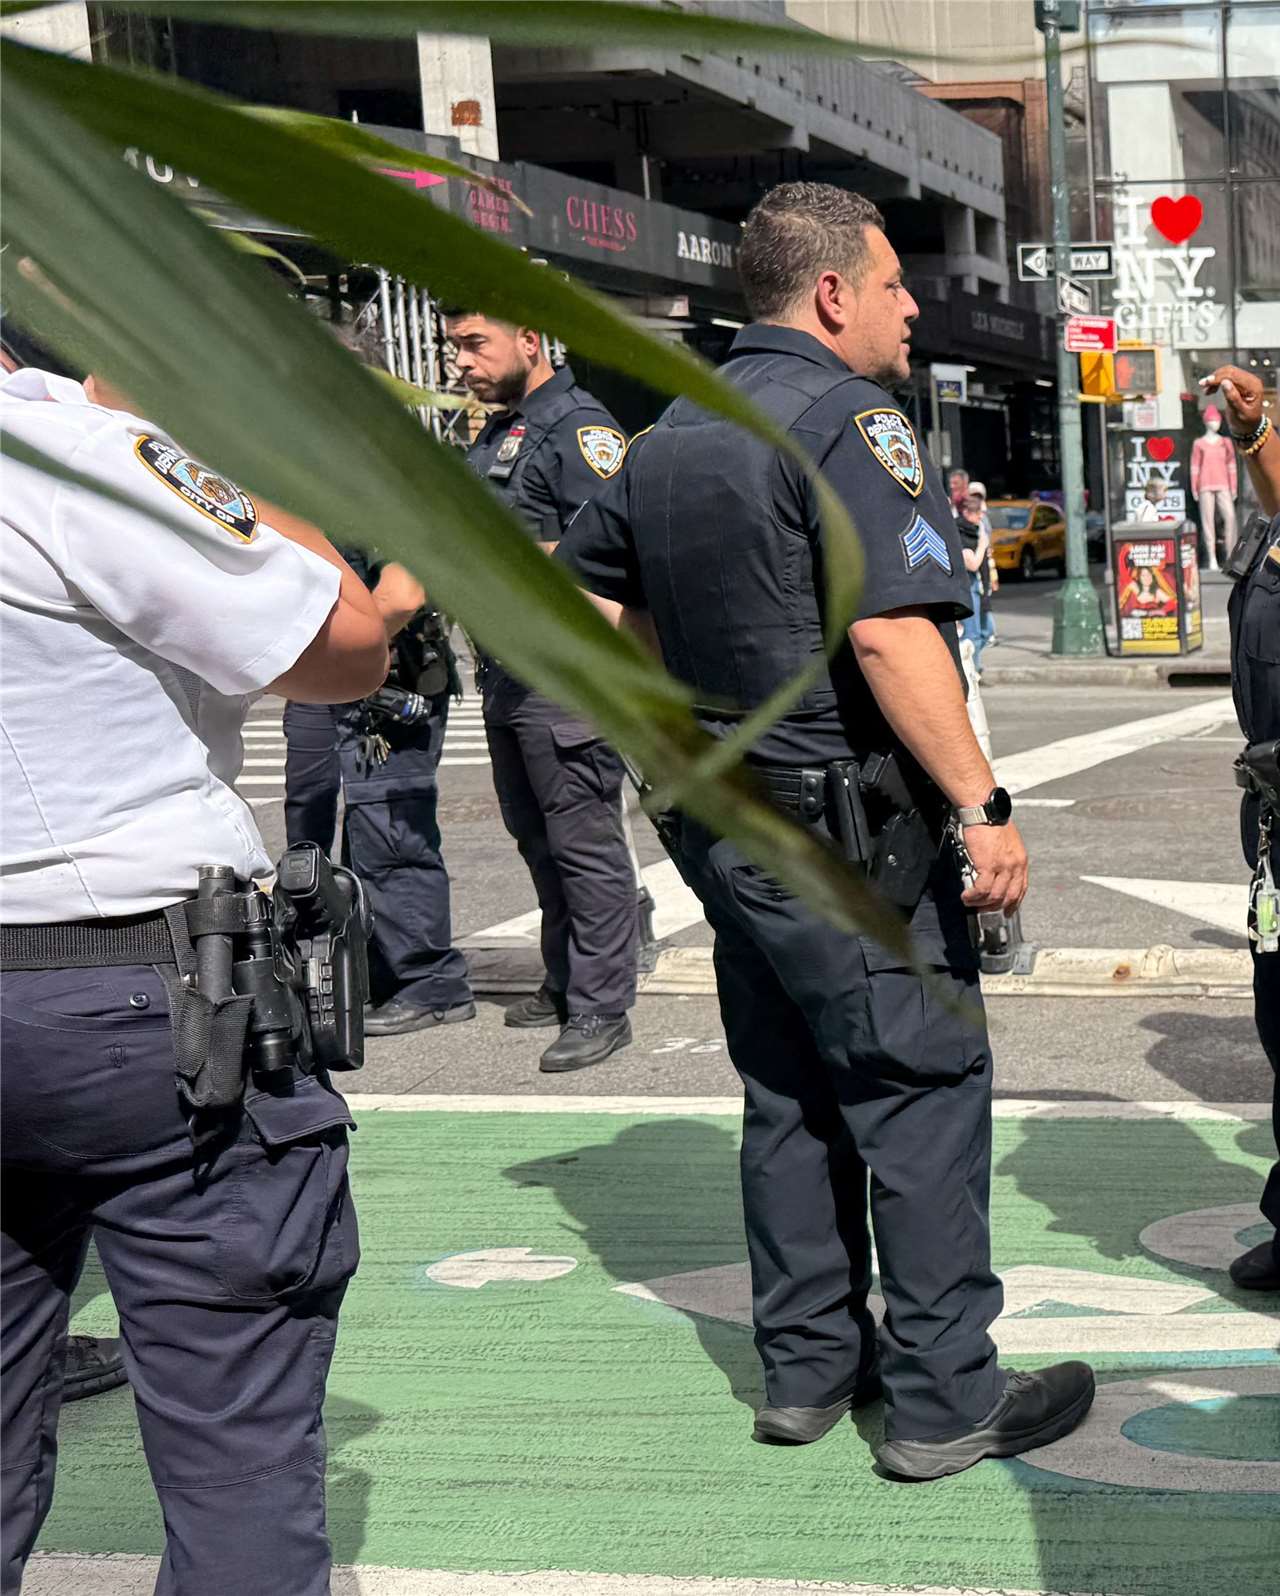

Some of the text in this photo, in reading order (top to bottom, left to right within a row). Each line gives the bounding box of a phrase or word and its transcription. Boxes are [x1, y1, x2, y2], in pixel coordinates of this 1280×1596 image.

[566, 195, 638, 242] CHESS
[1118, 196, 1148, 245] I
[677, 230, 733, 269] AARON
[1073, 255, 1102, 267] WAY
[1114, 301, 1217, 330] GIFTS
[1130, 436, 1146, 462] I
[1130, 496, 1181, 508] GTS
